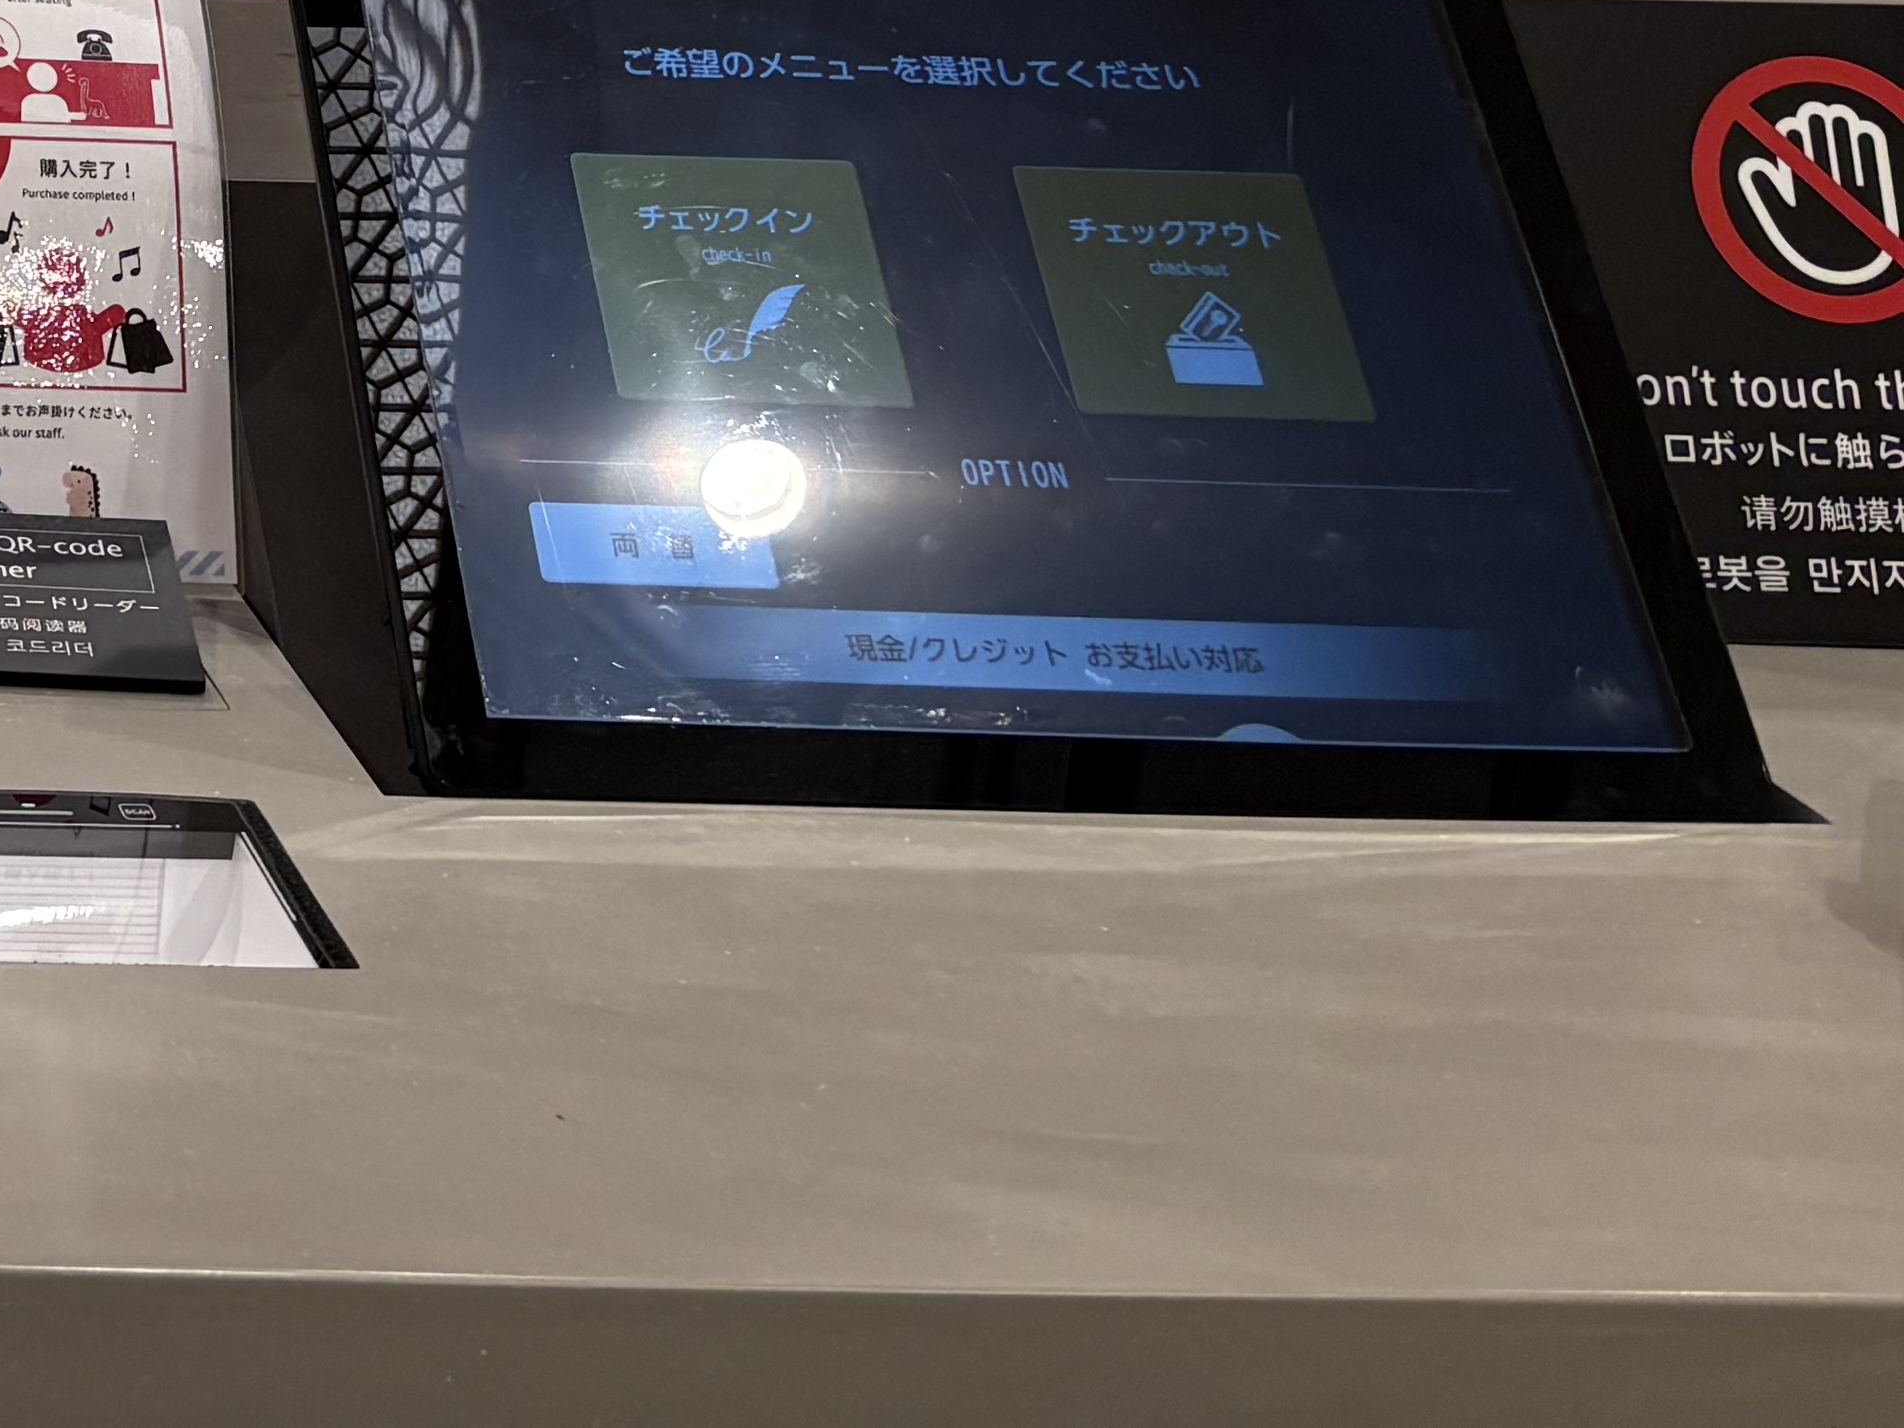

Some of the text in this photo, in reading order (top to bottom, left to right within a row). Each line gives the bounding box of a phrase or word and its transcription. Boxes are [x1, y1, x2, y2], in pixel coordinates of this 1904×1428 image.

[622, 46, 1198, 89] ご希望のメニューを選択してください
[22, 187, 70, 199] Purchase
[72, 190, 128, 202] completed
[634, 203, 818, 238] チェックイン
[1065, 216, 1280, 254] チェックアウト
[696, 243, 774, 266] check-in
[1636, 365, 1718, 406] on't
[1730, 368, 1861, 410] touch
[12, 428, 32, 438] our
[34, 426, 64, 439] staff.
[956, 458, 1069, 493] OPTION
[2, 594, 159, 612] コードリーダー
[6, 638, 93, 657] 코드리더
[840, 633, 1264, 676] 現金/クレジット お支払い対応
